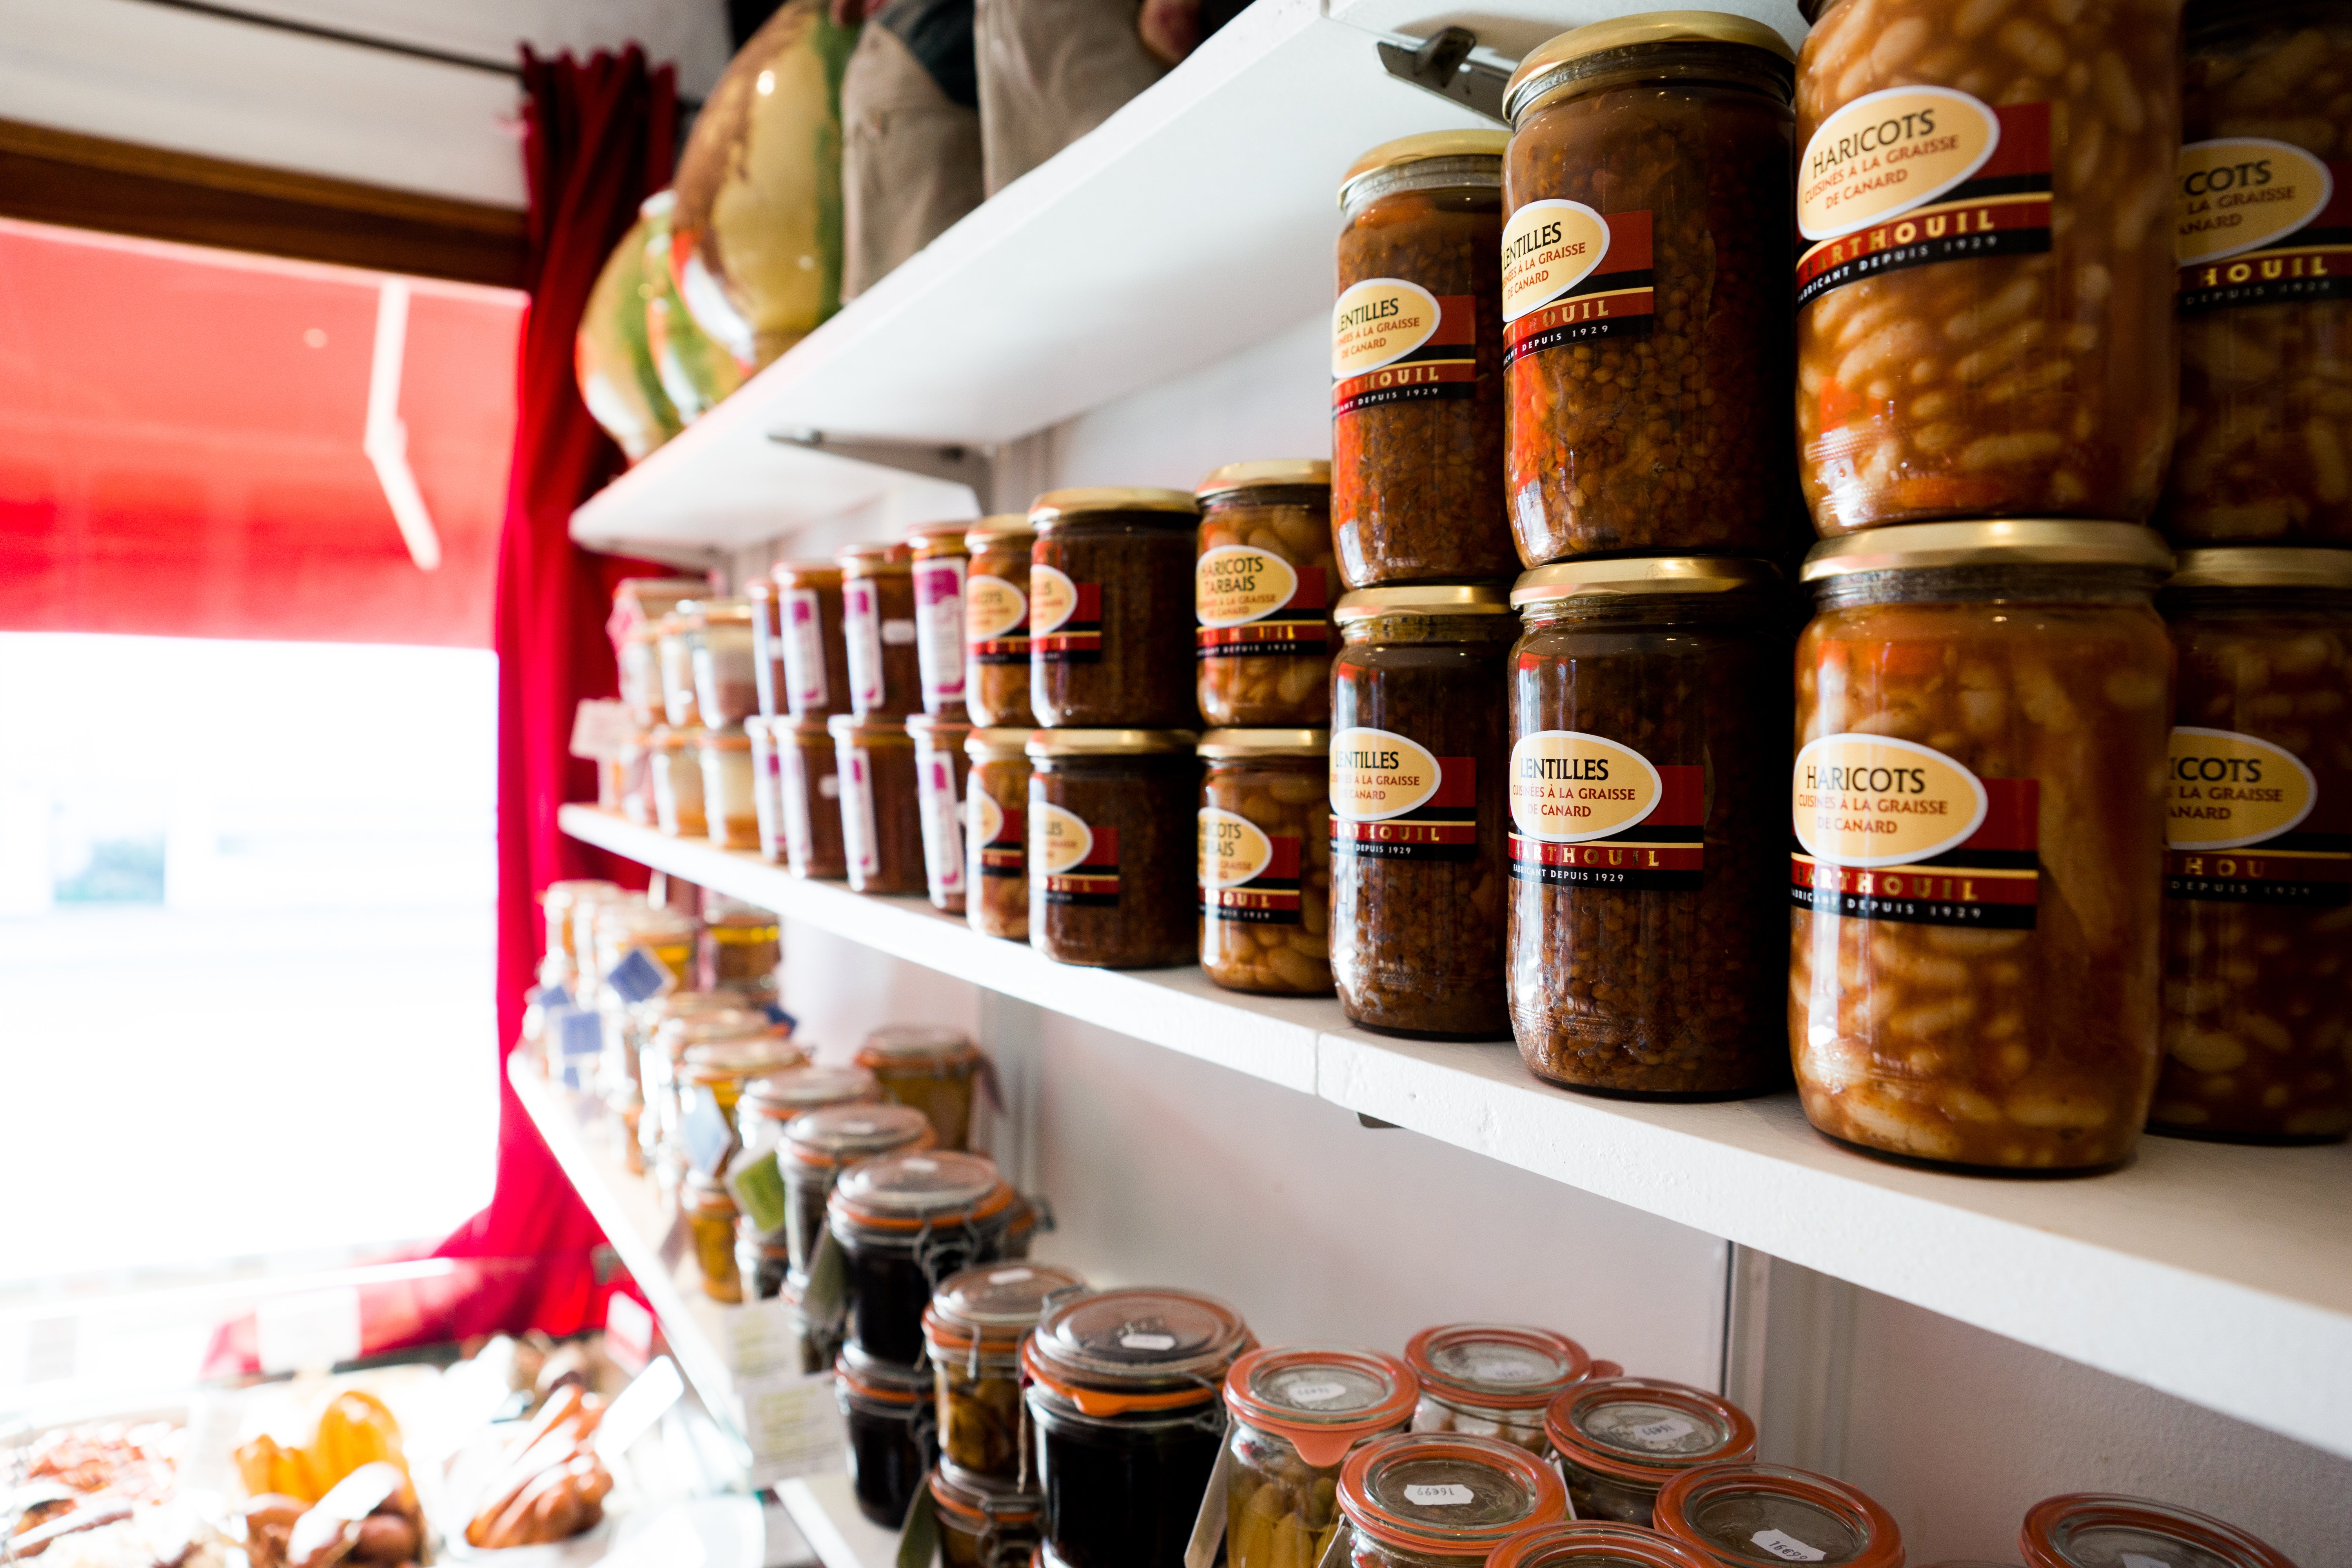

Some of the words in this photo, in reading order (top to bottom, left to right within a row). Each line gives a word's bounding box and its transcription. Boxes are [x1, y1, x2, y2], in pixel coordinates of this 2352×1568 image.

[1813, 108, 1935, 179] HARICOTS
[1848, 160, 1858, 178] À
[1862, 156, 1881, 173] LA
[1886, 134, 1960, 164] GRAISSE
[2184, 160, 2273, 196] COTS
[1826, 192, 1840, 210] DE
[1843, 168, 1908, 200] CANARD
[2187, 200, 2211, 215] LA
[2217, 185, 2296, 209] GRAISSE
[1503, 221, 1562, 271] LENTILLES
[1858, 245, 1928, 271] DEPUIS
[1944, 235, 1997, 253] 1929
[1518, 260, 1523, 275] À
[1525, 257, 1536, 271] LA
[1538, 241, 1586, 265] GRAISSE
[1508, 286, 1514, 300] DE
[1514, 270, 1549, 294] CANARD
[1338, 298, 1399, 334] LENTILLES
[1355, 326, 1361, 339] À
[1363, 326, 1374, 337] LA
[1376, 317, 1421, 333] GRAISSE
[1522, 333, 1562, 352] DEPUIS
[1572, 325, 1608, 338] 1929
[1350, 337, 1387, 356] CANARD
[1357, 391, 1397, 406] DEPUIS
[1406, 387, 1439, 397] 1929
[1336, 751, 1399, 770] LENTILLES
[1520, 757, 1609, 781] LENTILLES
[1354, 772, 1359, 784] À
[1362, 775, 1373, 784] LA
[1376, 775, 1420, 786] GRAISSE
[1806, 765, 1926, 794] HARICOTS
[1349, 789, 1386, 800] CANARD
[1513, 783, 1544, 798] CUISINÉES
[1547, 784, 1555, 798] À
[1559, 787, 1574, 799] LA
[1578, 788, 1636, 800] GRAISSE
[2180, 786, 2201, 799] LA
[2209, 787, 2283, 802] GRAISSE
[1528, 803, 1538, 814] DE
[1541, 804, 1592, 817] CANARD
[1840, 794, 1848, 810] À
[1853, 798, 1871, 811] LA
[1877, 798, 1949, 815] GRAISSE
[1817, 816, 1830, 829] DE
[1835, 817, 1898, 834] CANARD
[1356, 844, 1383, 853] DEPUIS
[1389, 846, 1411, 854] 1929
[1513, 863, 1546, 877] FABRICANT
[1550, 869, 1588, 880] DEPUIS
[1595, 873, 1624, 882] 1929
[1846, 898, 1915, 915] DEPUIS
[1930, 905, 1982, 919] 1929
[1417, 1487, 1454, 1496] 16€99
[1768, 1541, 1808, 1560] 16€99
